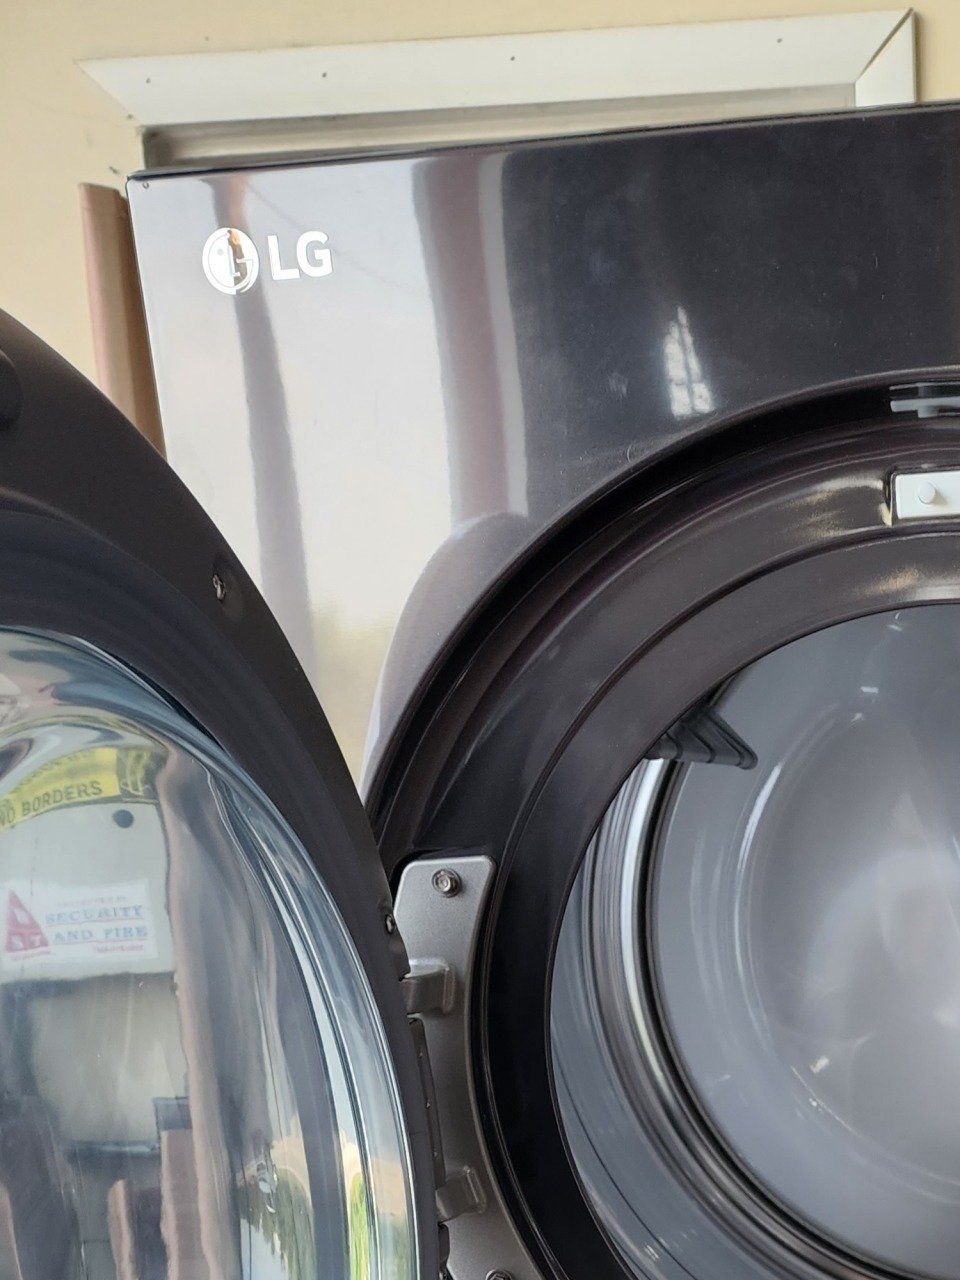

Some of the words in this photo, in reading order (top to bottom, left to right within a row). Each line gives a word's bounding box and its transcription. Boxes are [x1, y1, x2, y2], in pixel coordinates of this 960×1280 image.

[267, 230, 333, 281] LG
[22, 780, 103, 816] BORDERS
[54, 929, 93, 943] AND
[103, 926, 148, 940] FIRE
